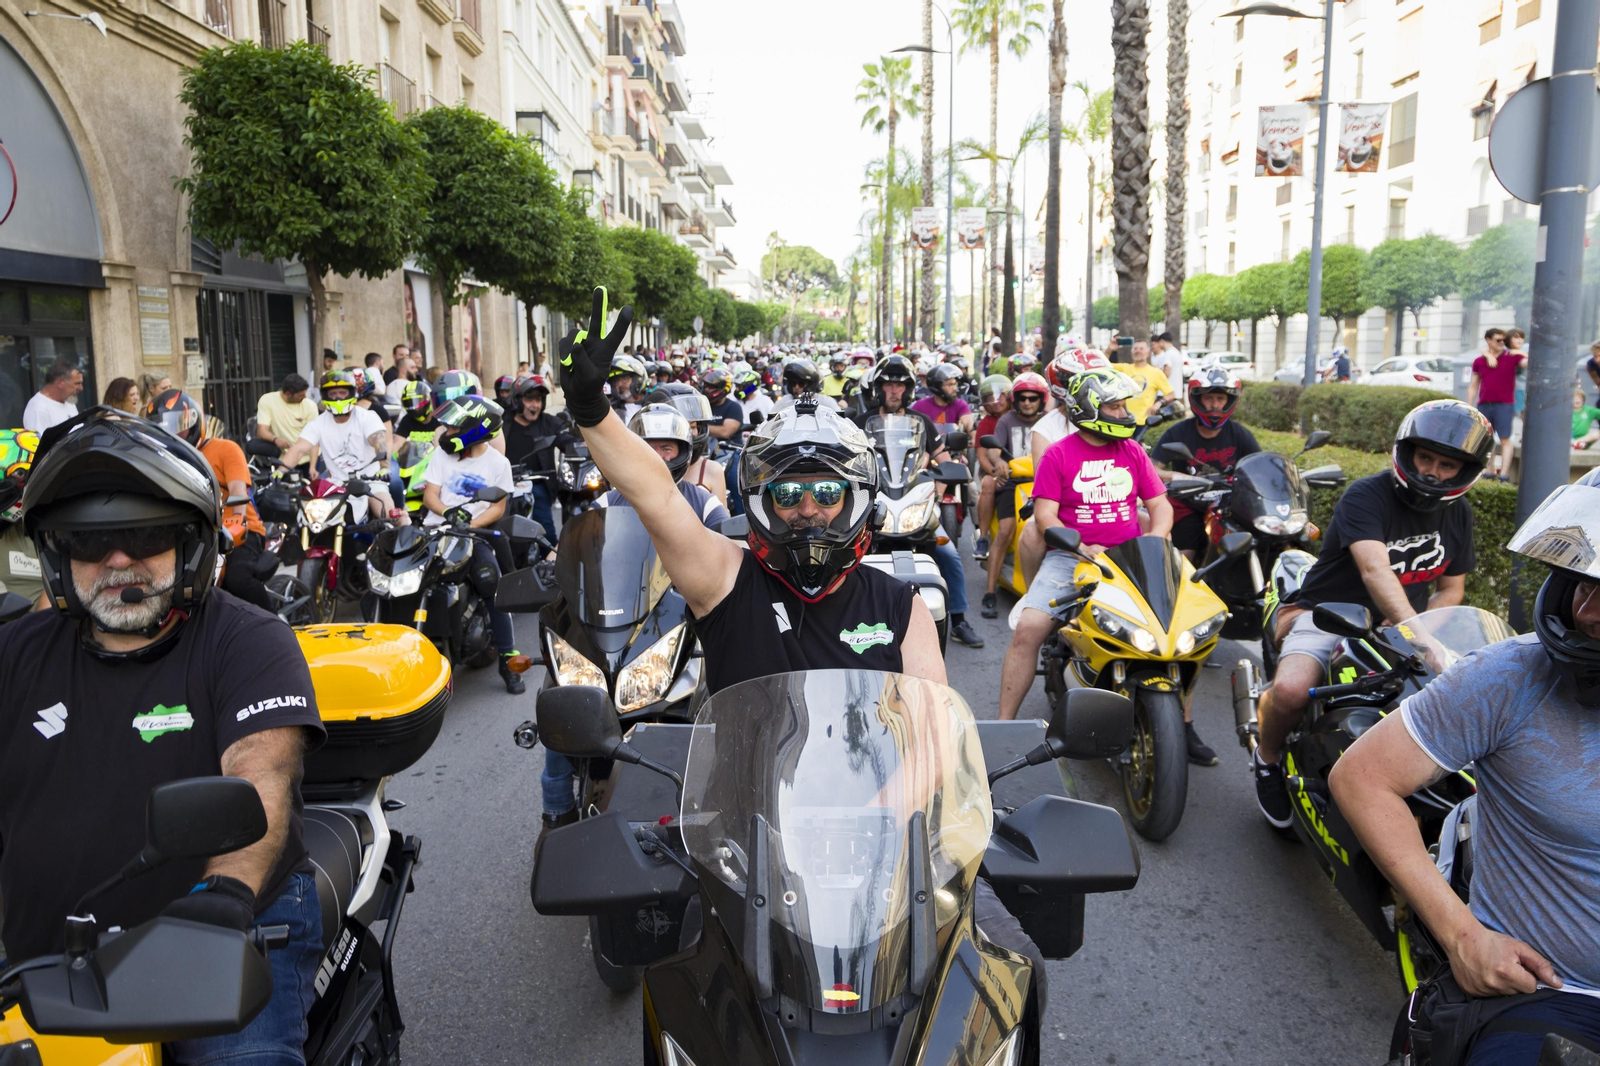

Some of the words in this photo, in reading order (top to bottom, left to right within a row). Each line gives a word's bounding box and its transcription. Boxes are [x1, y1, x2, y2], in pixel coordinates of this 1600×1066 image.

[1080, 459, 1115, 478] NIKE
[598, 608, 624, 616] SUZUKI
[236, 695, 307, 722] SUZUKI
[1286, 751, 1349, 867] SZUKI
[340, 936, 358, 972] SUZUKI
